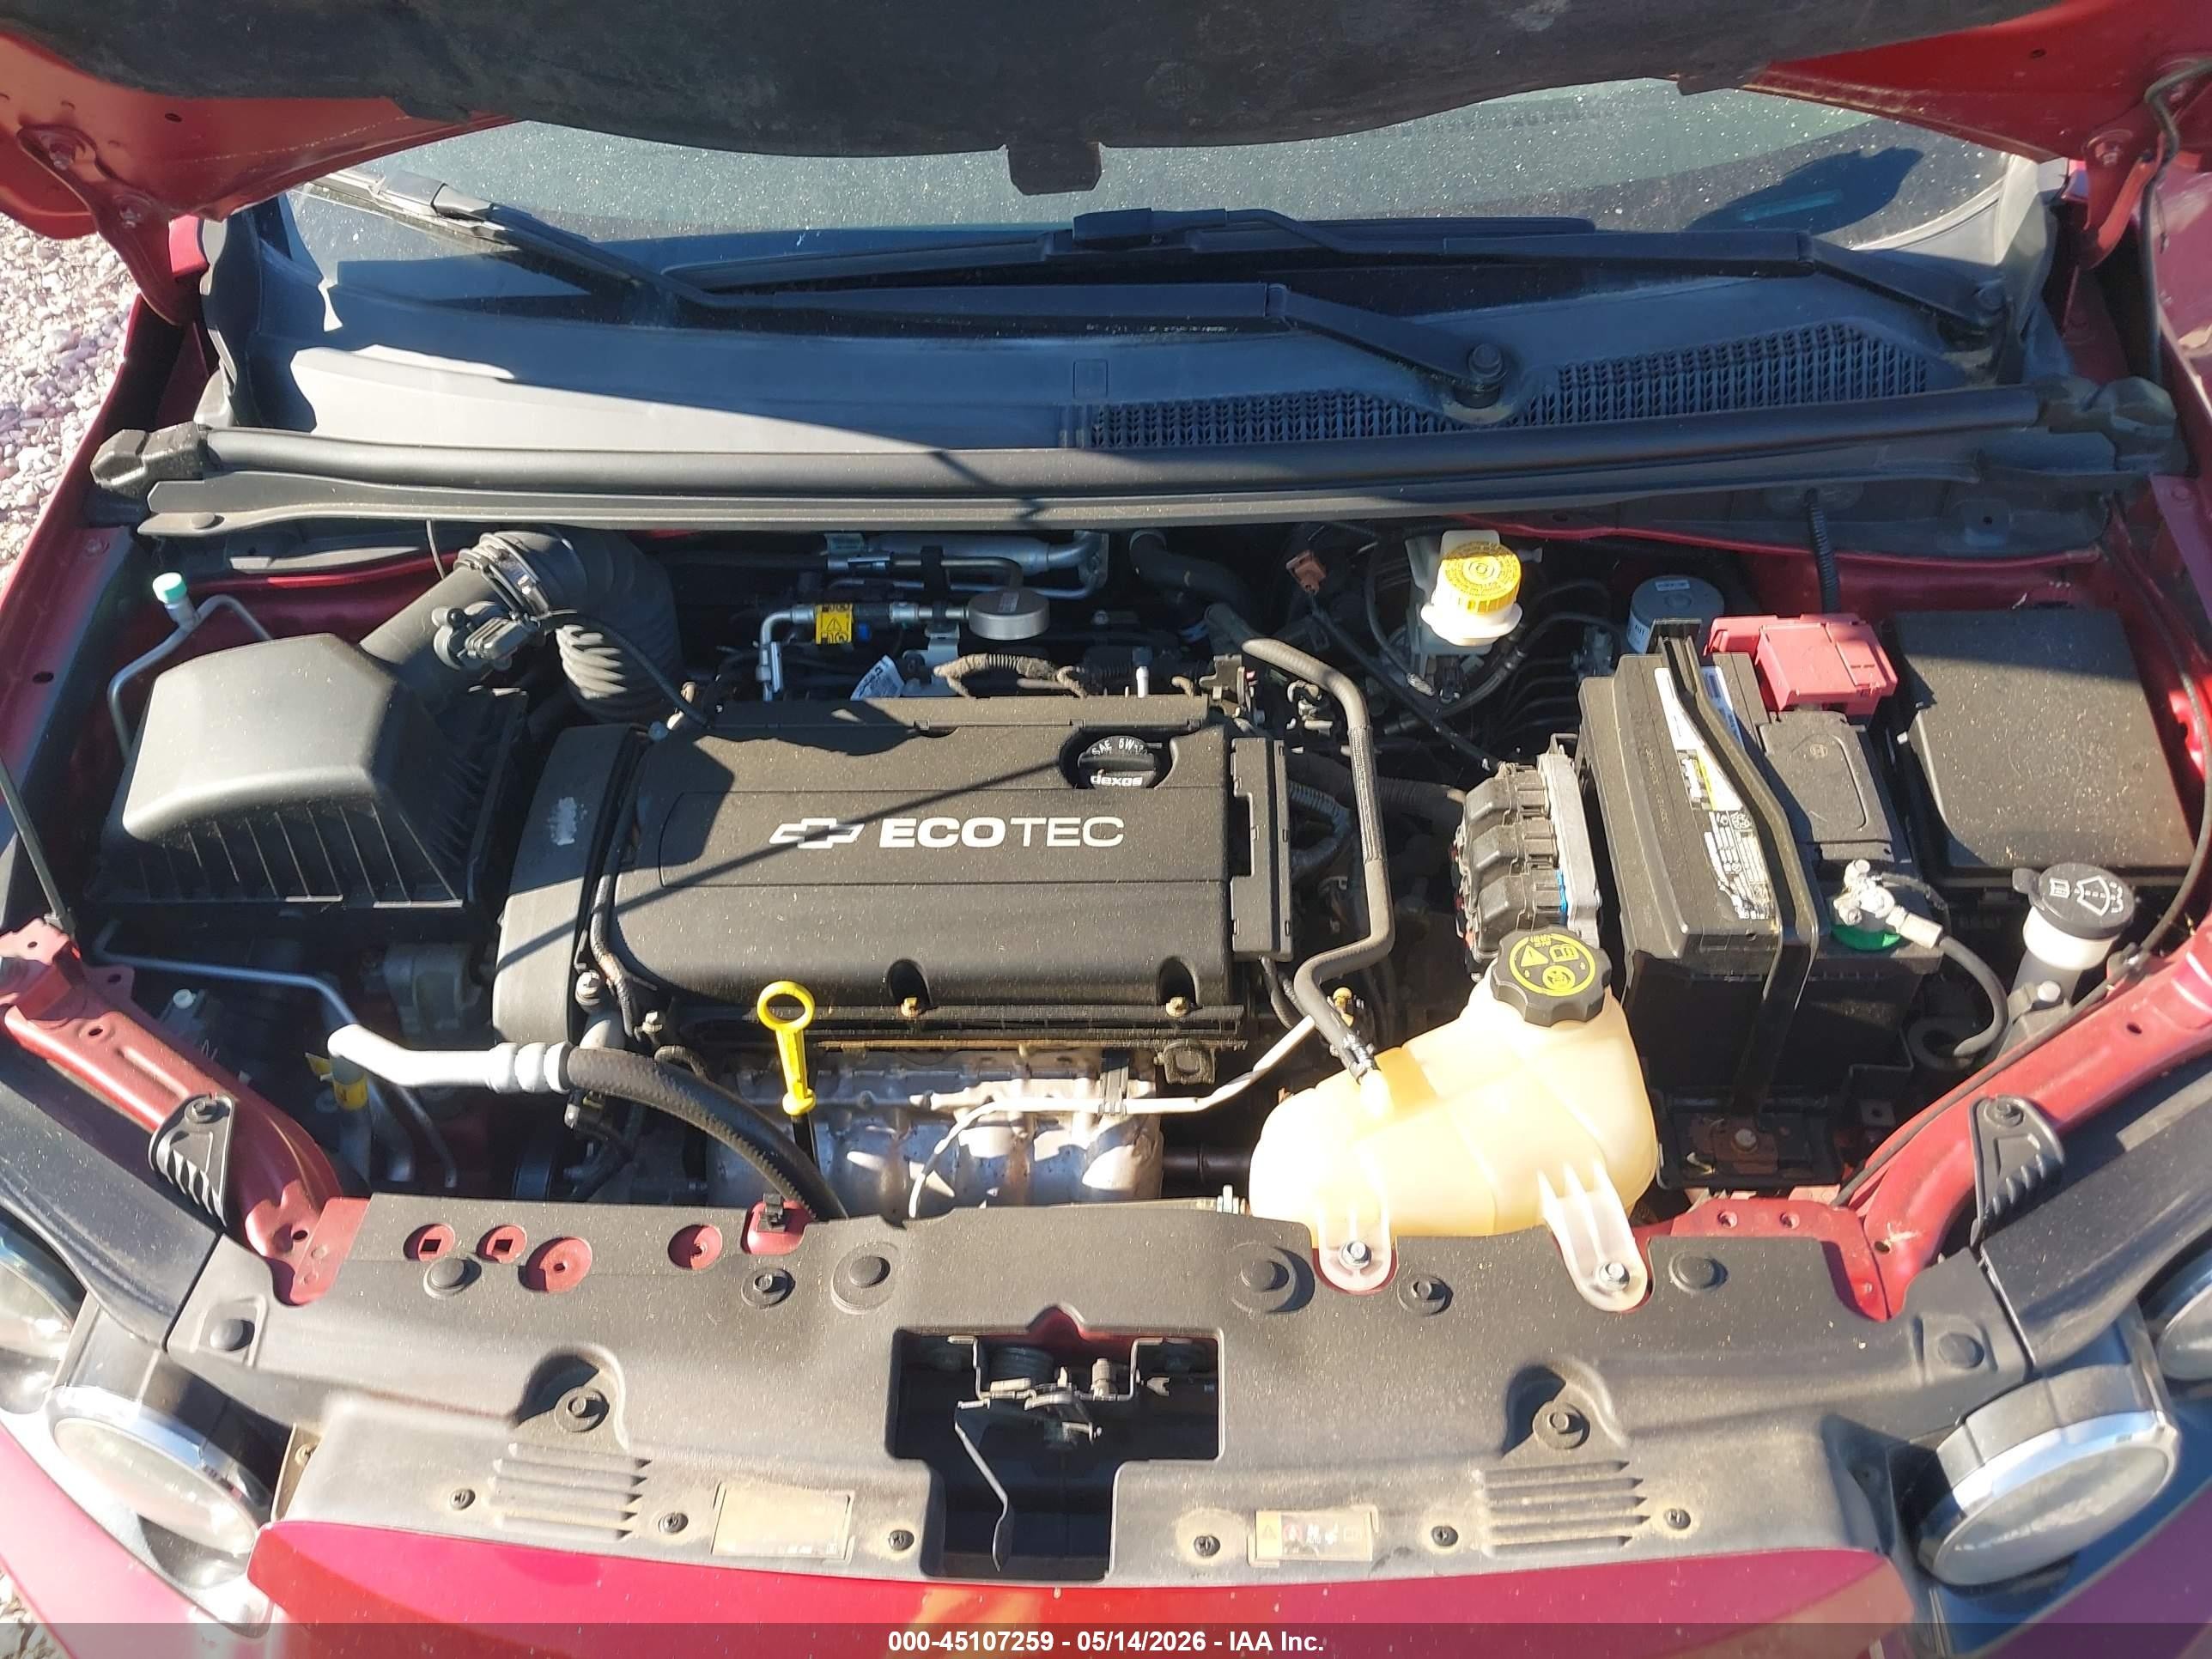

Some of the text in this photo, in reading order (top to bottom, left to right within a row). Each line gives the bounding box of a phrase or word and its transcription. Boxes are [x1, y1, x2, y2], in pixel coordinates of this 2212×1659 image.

[1091, 739, 1113, 756] SAE
[1090, 773, 1143, 787] dexos
[878, 817, 1125, 848] ECOTEC
